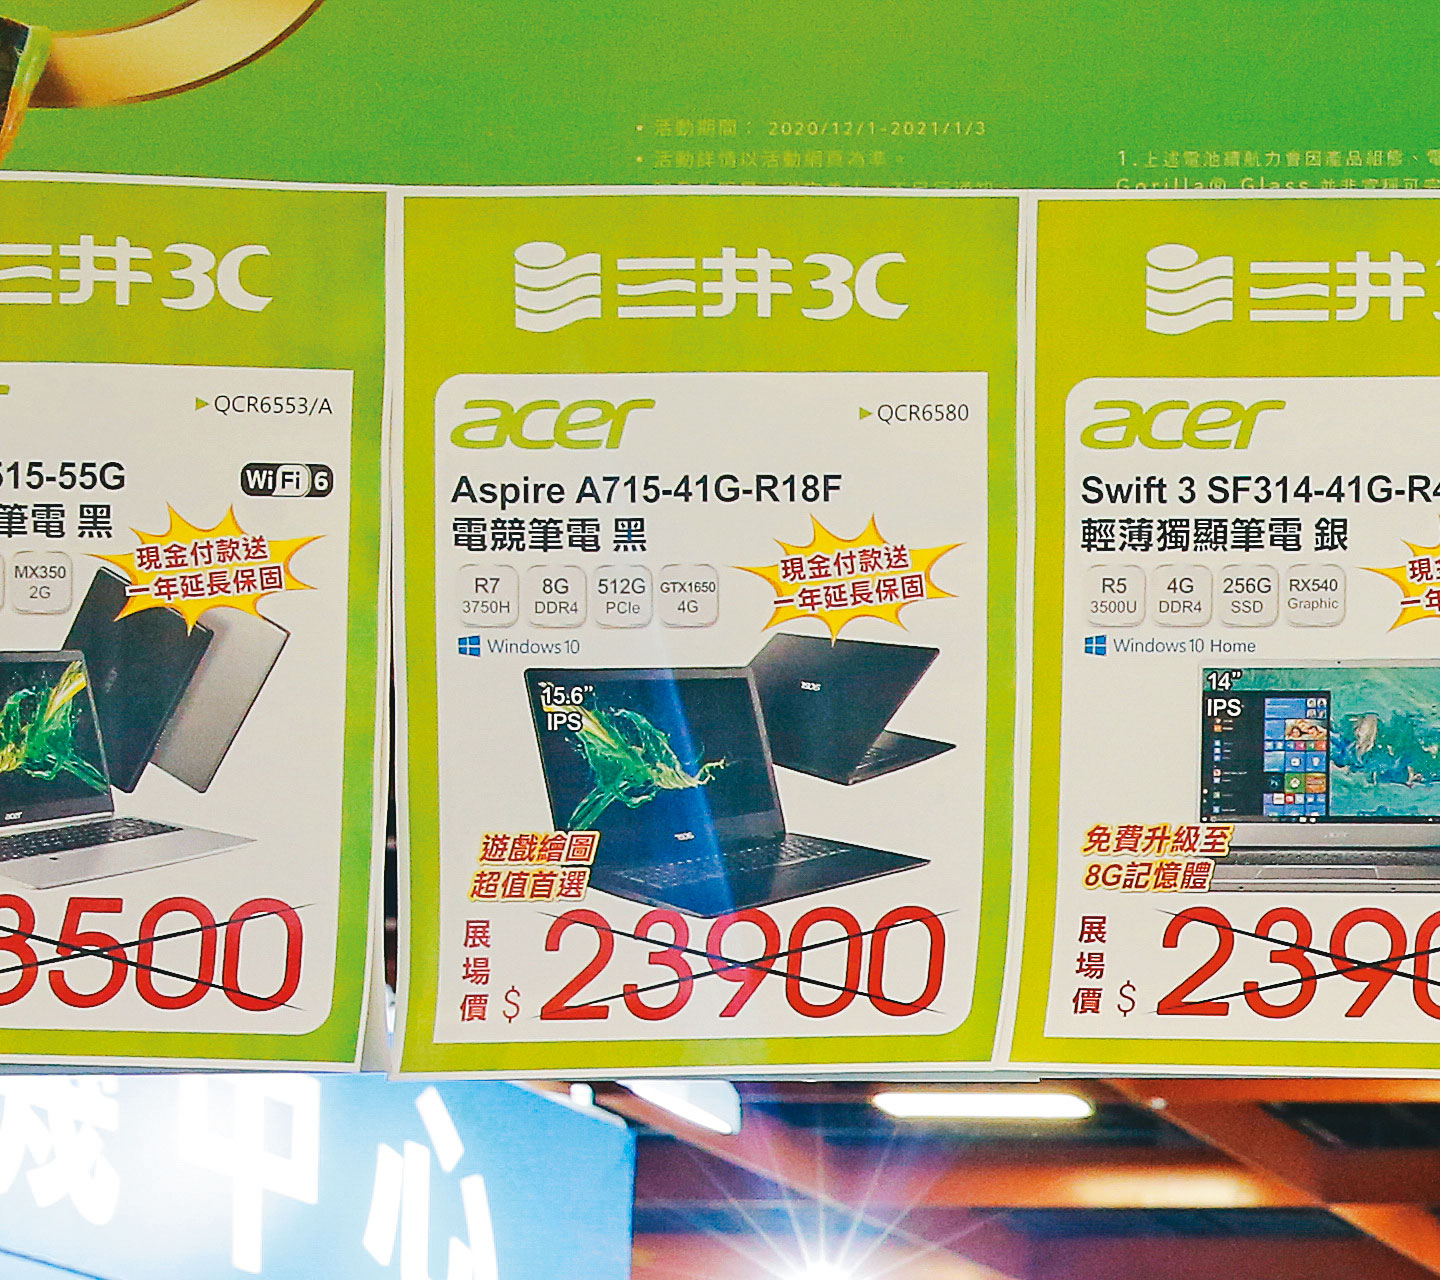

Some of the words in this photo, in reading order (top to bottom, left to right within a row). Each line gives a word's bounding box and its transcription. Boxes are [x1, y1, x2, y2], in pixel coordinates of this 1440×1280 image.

[768, 121, 987, 136] 2020/12/1-2021/1/3
[616, 245, 909, 322] 三井3C
[214, 395, 333, 416] QCR6553/A
[877, 403, 969, 424] QCR6580
[450, 398, 656, 450] acer
[1079, 399, 1286, 451] acer
[451, 475, 566, 510] Aspire
[575, 472, 843, 504] A715-41G-R18F
[1080, 475, 1168, 505] Swift
[1178, 476, 1196, 504] 3
[78, 504, 113, 539] 黑
[451, 517, 600, 553] 電競筆電
[613, 517, 647, 552] 黑
[1080, 518, 1301, 553] 輕薄獨顯筆電
[1314, 517, 1348, 552] 銀
[136, 536, 268, 572] 現金付款送
[14, 565, 67, 580] MX350
[125, 566, 284, 601] 一年延長保固
[1288, 577, 1338, 593] RX540
[1287, 596, 1339, 613] Graphic
[487, 638, 559, 656] Windows
[560, 638, 580, 655] 10
[1206, 698, 1242, 717] IPS
[478, 831, 596, 866] 遊戲繪圖
[1082, 825, 1230, 855] 免費升級至
[469, 869, 590, 902] 超值首選
[1083, 861, 1213, 891] 8G記憶體
[459, 918, 491, 1022] 展場價
[540, 904, 947, 1022] 23900
[1072, 915, 1107, 1017] 展場價
